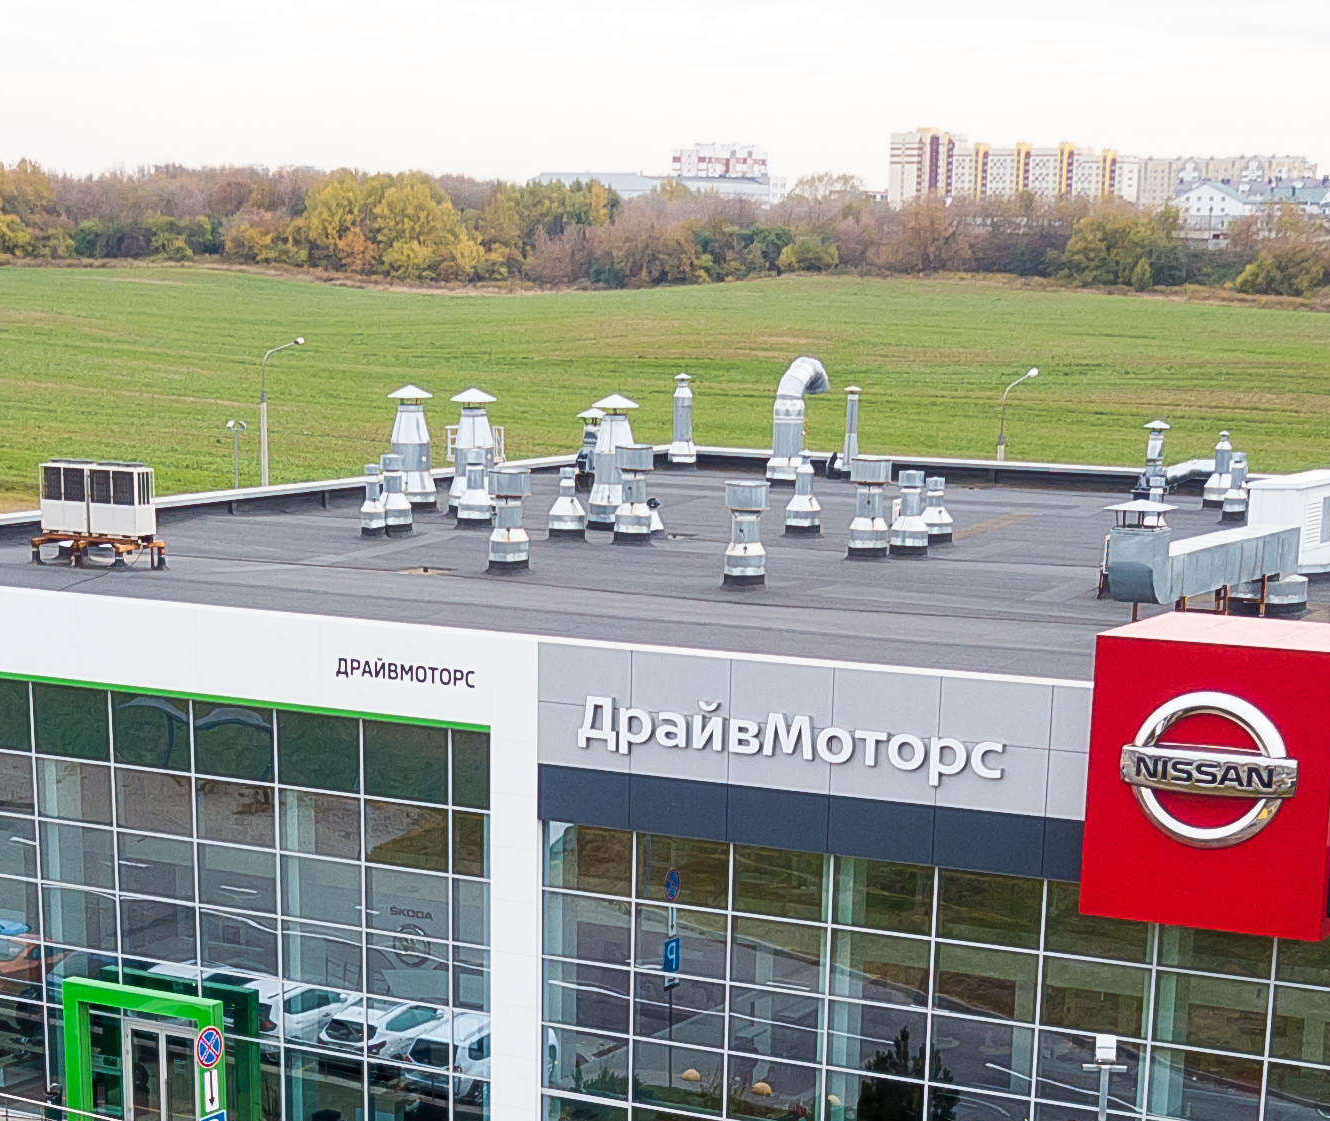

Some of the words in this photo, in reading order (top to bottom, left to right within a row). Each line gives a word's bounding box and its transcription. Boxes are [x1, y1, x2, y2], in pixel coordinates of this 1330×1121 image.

[335, 656, 476, 689] ДРАЙВМОТОРС
[576, 694, 1007, 788] ДрайвМоторс
[1134, 755, 1275, 790] NISSAN
[390, 905, 434, 922] ŠKODA
